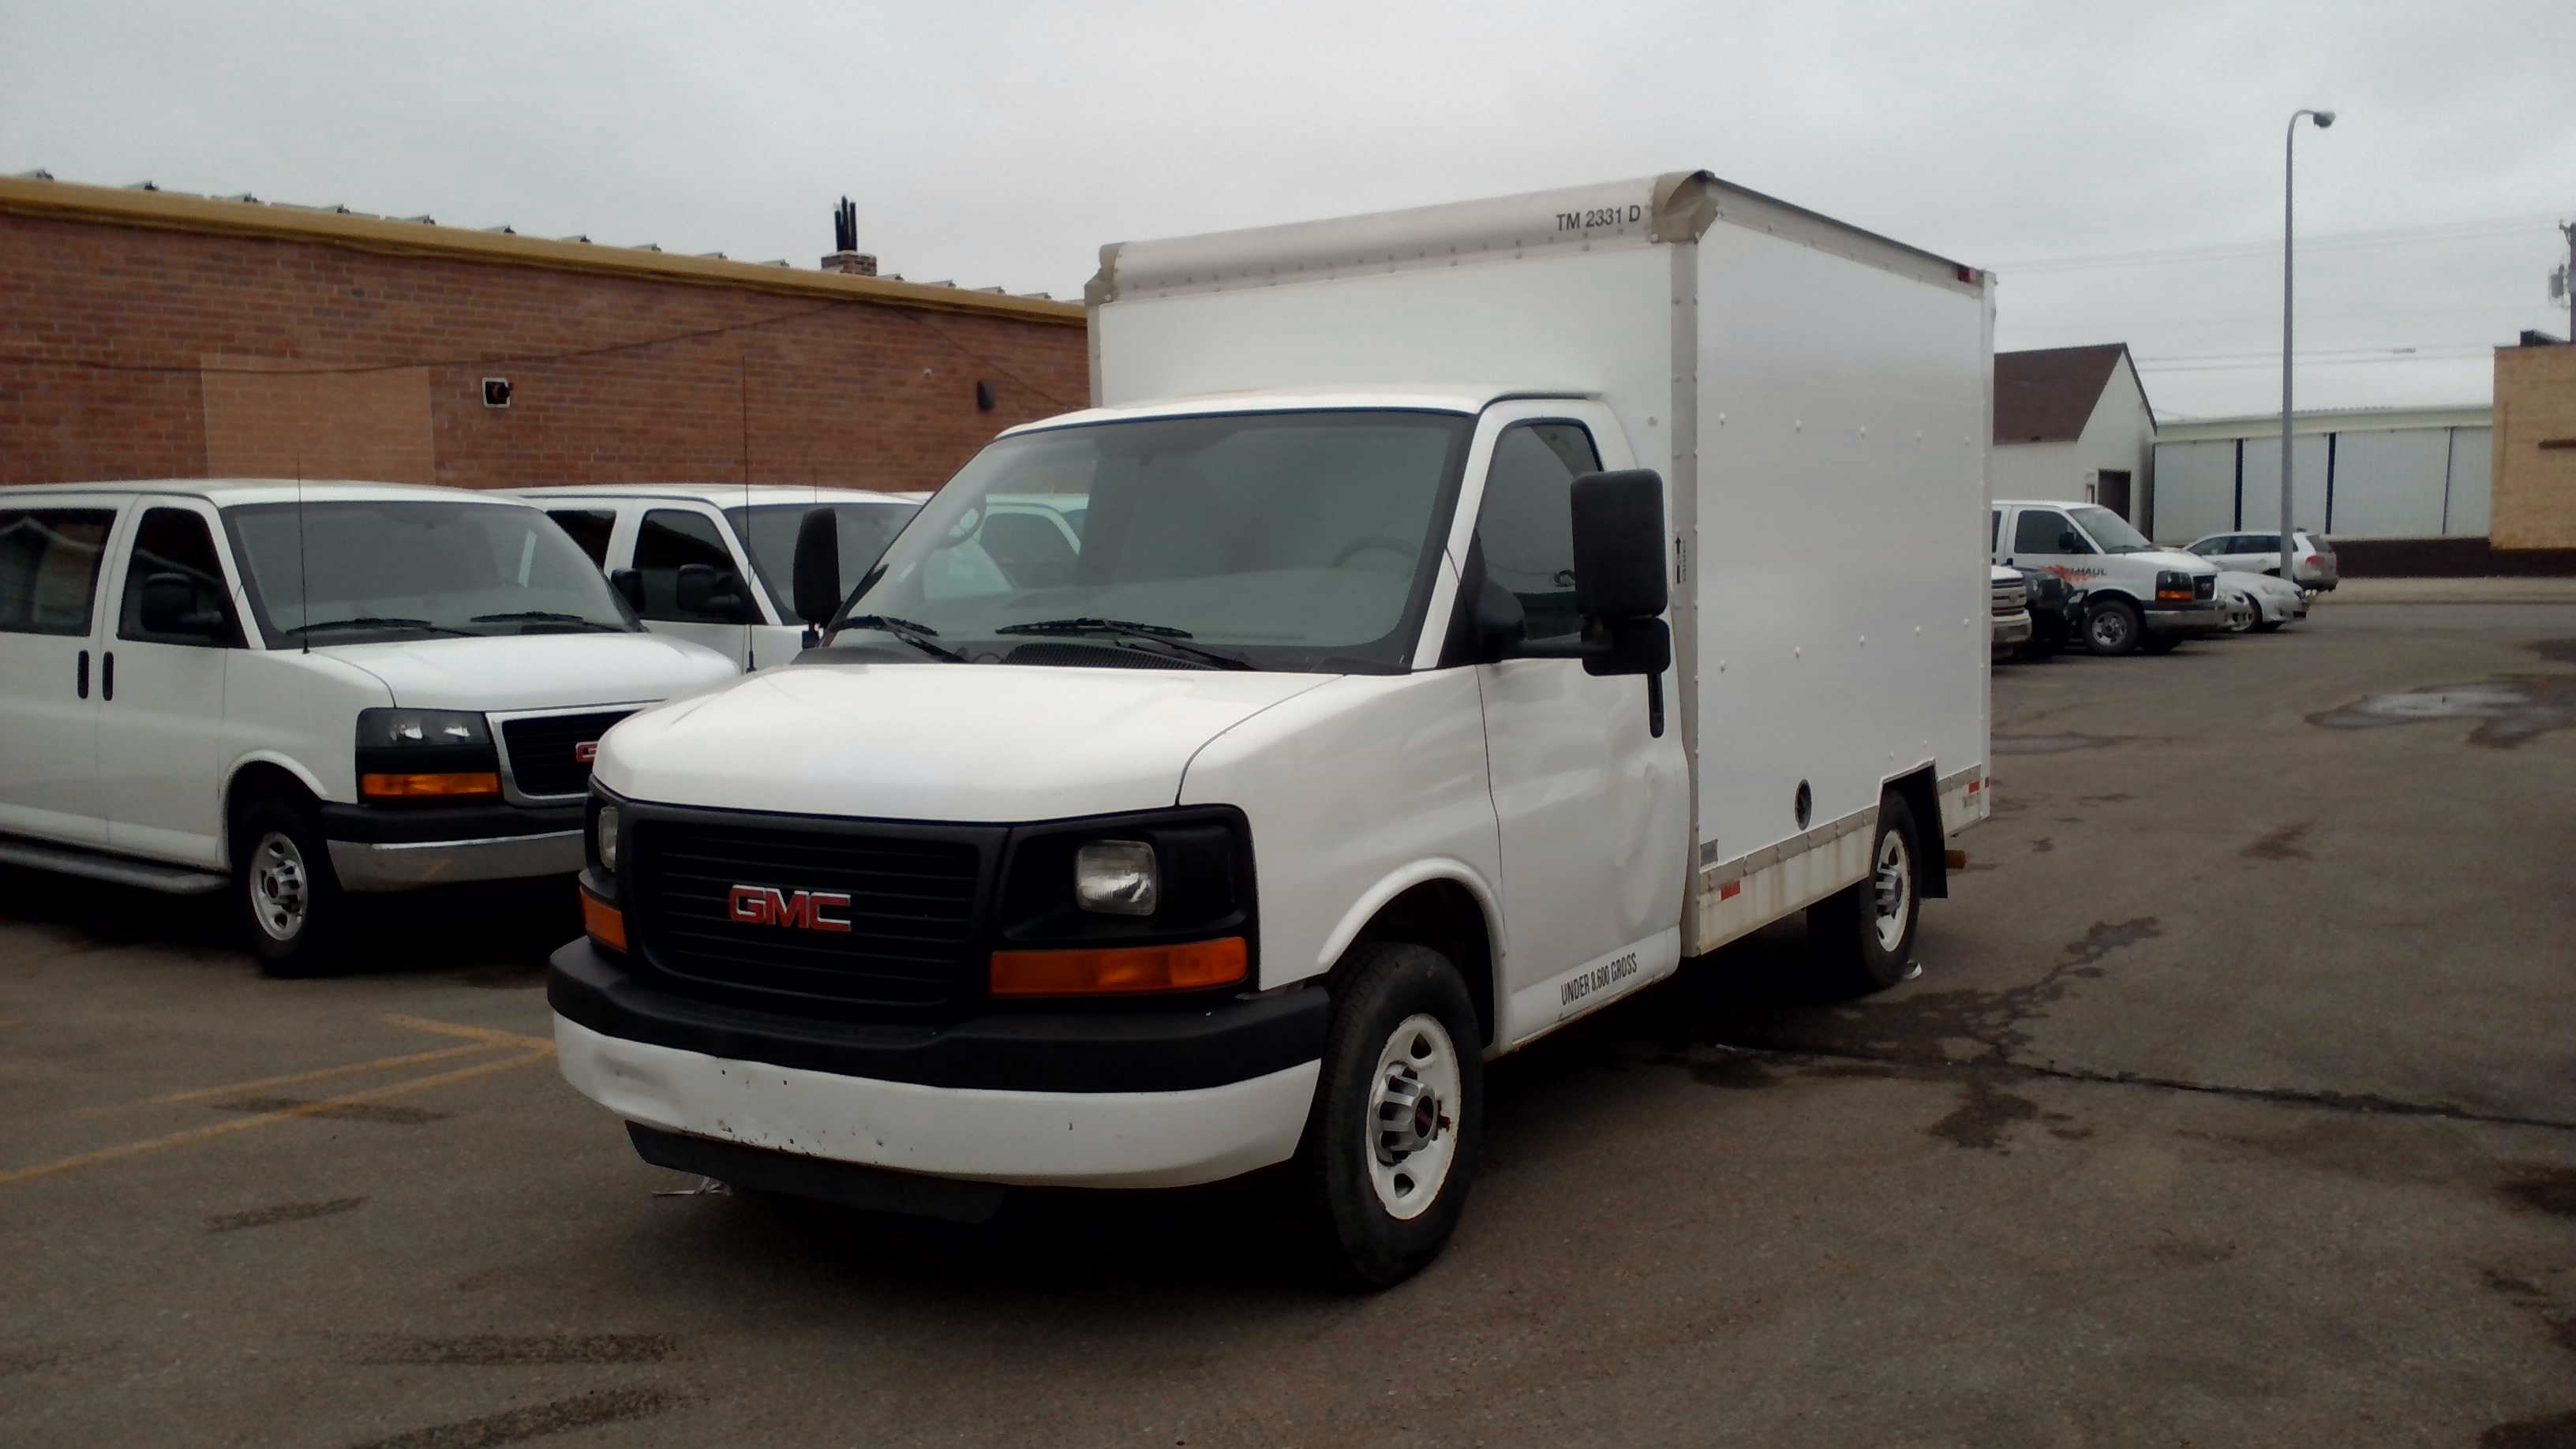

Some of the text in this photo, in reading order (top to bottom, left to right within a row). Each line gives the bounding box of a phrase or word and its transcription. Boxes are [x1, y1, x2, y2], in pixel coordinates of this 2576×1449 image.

[1556, 204, 1641, 231] TM 2331 D
[729, 884, 852, 932] GMC
[1561, 952, 1637, 1005] UNDER 8,600 GROSS
